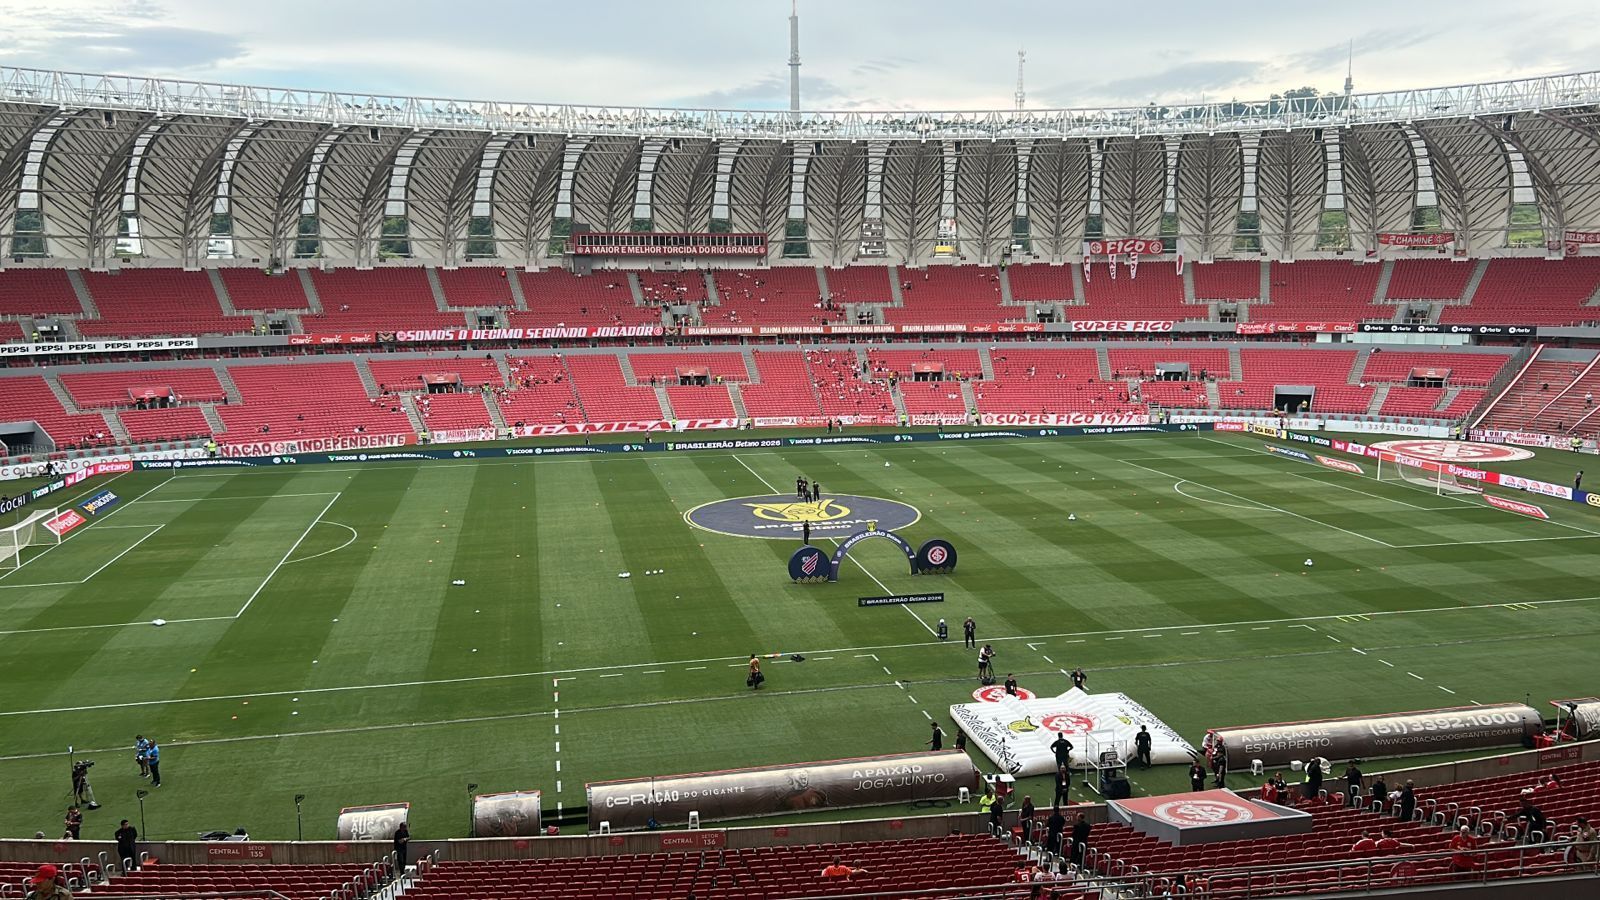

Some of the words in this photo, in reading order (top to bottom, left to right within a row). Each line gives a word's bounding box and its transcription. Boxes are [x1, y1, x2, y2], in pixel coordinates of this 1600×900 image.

[584, 246, 591, 254] A
[592, 246, 619, 254] MAIOR
[621, 246, 626, 254] E
[627, 246, 662, 254] MELHOR
[662, 246, 697, 254] TORCIDA
[699, 246, 711, 254] DO
[711, 246, 724, 254] RIO
[726, 246, 758, 254] GRANDE
[1107, 241, 1145, 254] FICO
[1073, 321, 1128, 331] SUPER
[1132, 321, 1172, 331] FICO
[320, 335, 341, 343] Claro
[350, 334, 370, 342] Claro
[406, 330, 455, 341] SOMOS
[458, 330, 468, 340] O
[471, 327, 523, 340] DECIMO
[525, 327, 588, 339] SEGUNDO
[591, 326, 653, 338] JOGADOR
[0, 346, 29, 354] PEPSI
[996, 414, 1048, 425] SUPER
[1052, 414, 1095, 425] FICO
[1100, 413, 1133, 424] 1977
[531, 421, 672, 435] CAMISA
[297, 434, 405, 453] INDEPENDENTE
[675, 440, 734, 450] BRASILEIRÃO
[1, 461, 91, 476] COLOADO
[97, 462, 130, 472] Betano
[1448, 464, 1487, 480] SUPERBET
[0, 495, 26, 513] GOCHI
[844, 530, 886, 549] BRASILEIRÃO
[886, 533, 902, 545] Betano
[866, 597, 908, 605] BRASILEIRÃO
[1368, 720, 1408, 736] (51)
[1411, 711, 1520, 732] 3392.1000
[1241, 735, 1251, 743] A
[1311, 728, 1331, 736] DE
[1245, 741, 1287, 753] ESTAR
[1287, 737, 1333, 750] PERTO.
[1541, 753, 1562, 761] CENTRAL
[852, 770, 863, 778] A
[854, 778, 894, 791] JOGA
[896, 773, 948, 787] JUNTO.
[606, 789, 679, 808] CORAÇÃO
[684, 790, 698, 799] DO
[702, 786, 746, 797] GIGANTE
[250, 850, 264, 858] 135
